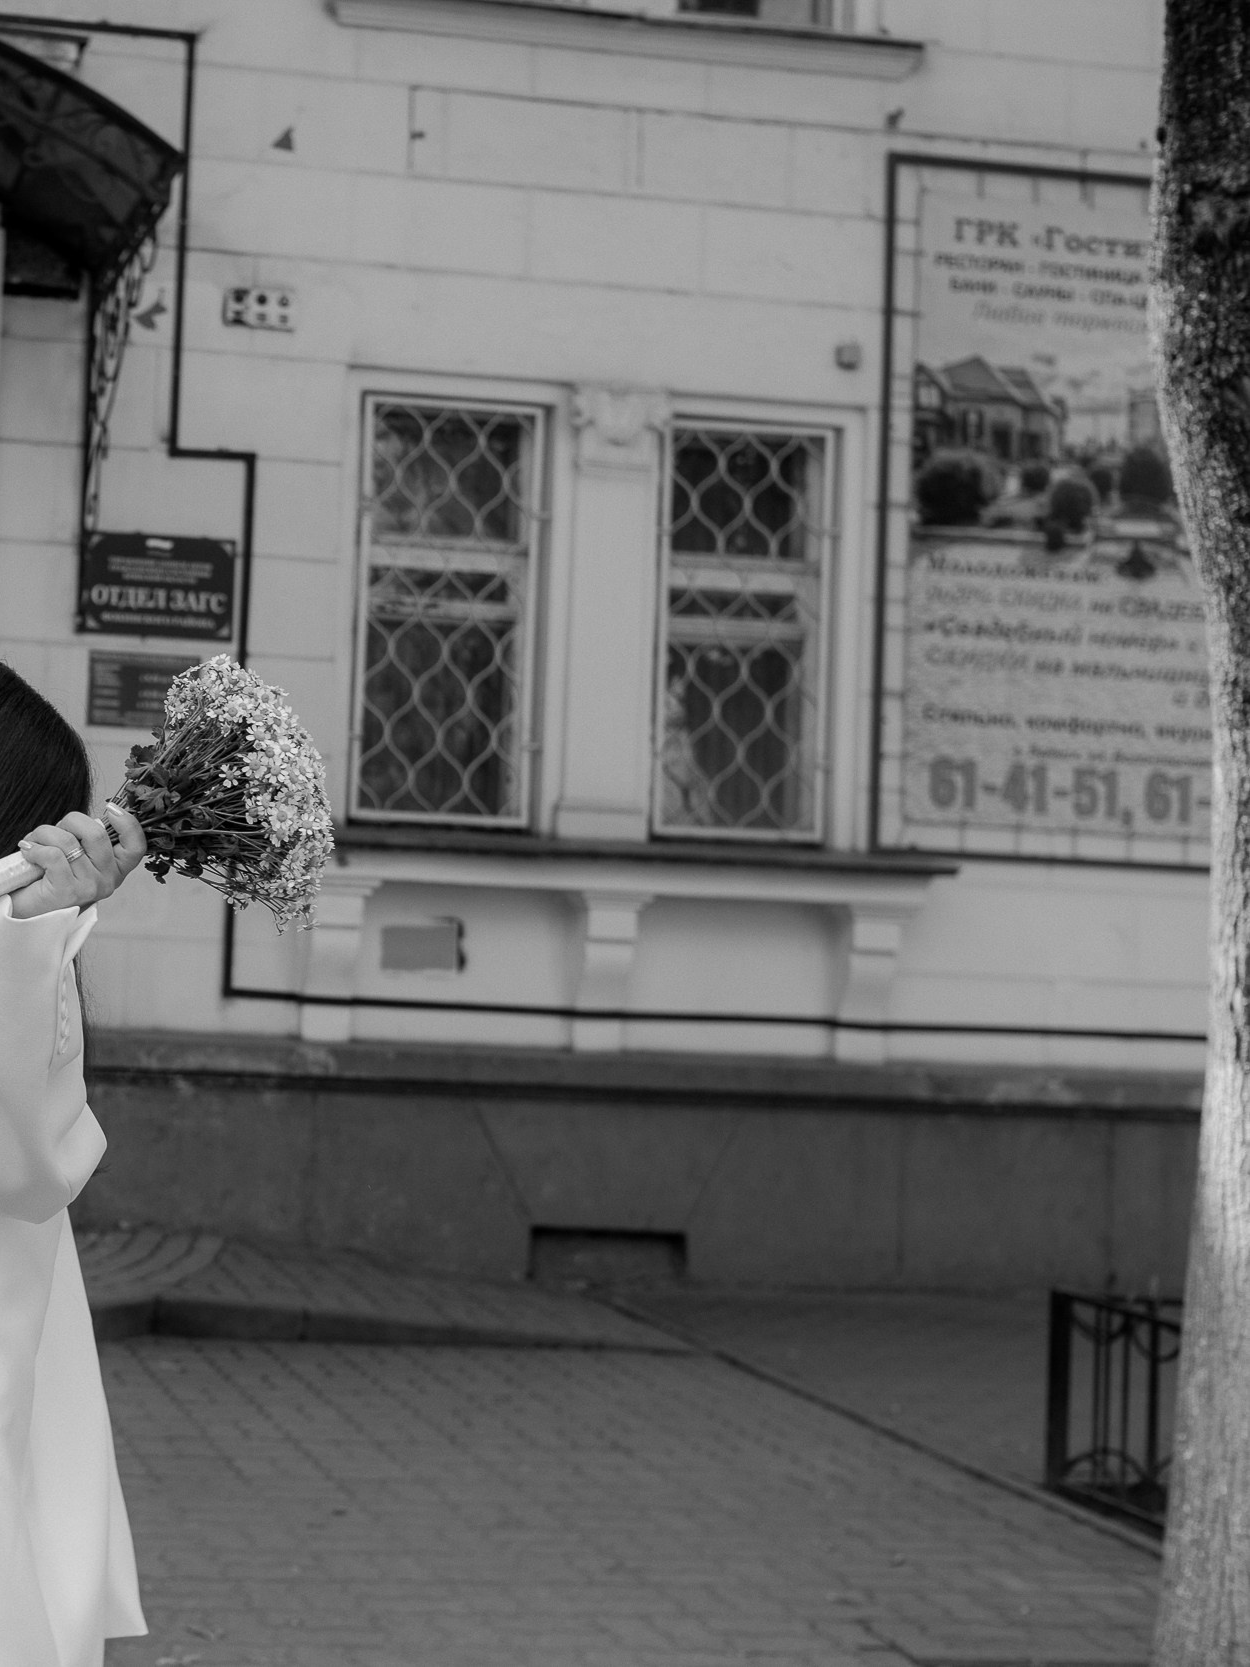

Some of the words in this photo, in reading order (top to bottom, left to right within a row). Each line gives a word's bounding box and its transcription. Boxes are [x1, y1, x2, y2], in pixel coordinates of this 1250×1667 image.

[955, 217, 1018, 249] ГРК
[91, 584, 167, 610] ОТДЕЛ
[169, 588, 228, 615] ЗАГС
